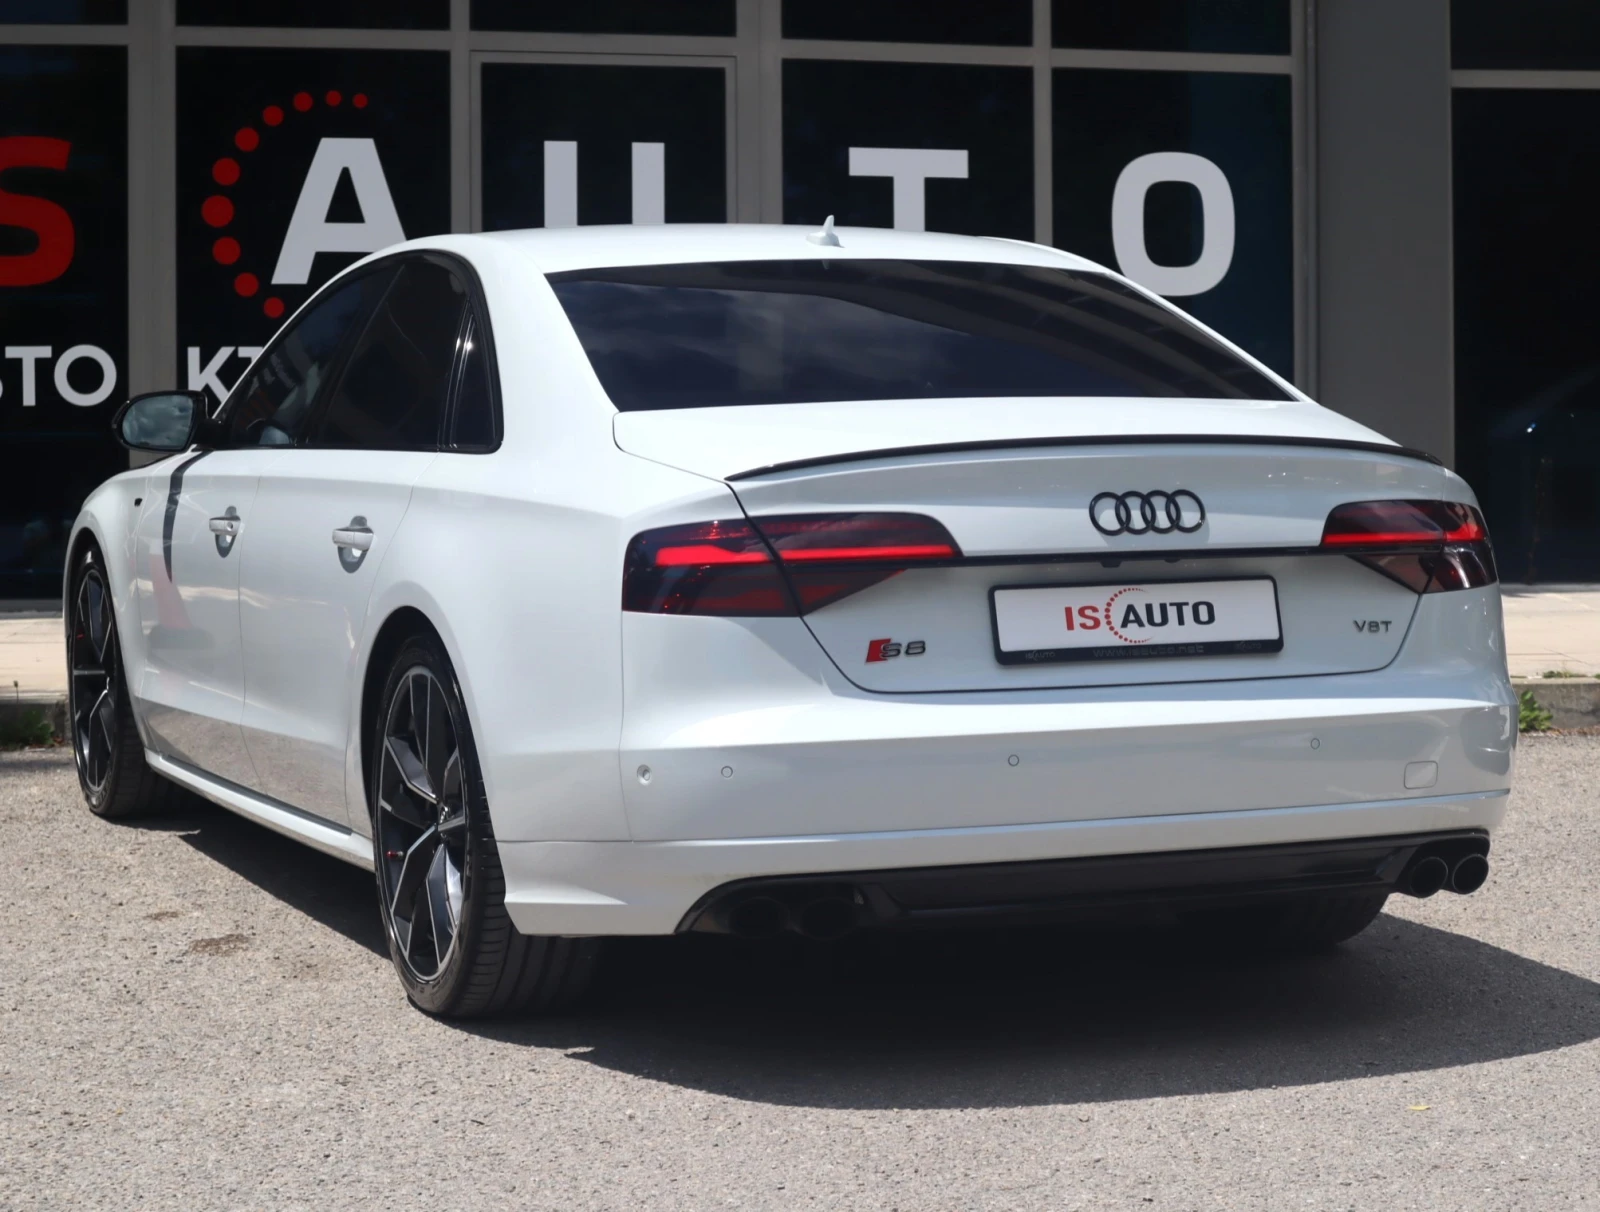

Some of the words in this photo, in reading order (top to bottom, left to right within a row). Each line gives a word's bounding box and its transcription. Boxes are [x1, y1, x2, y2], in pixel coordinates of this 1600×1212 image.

[1064, 605, 1101, 631] IS
[1120, 600, 1216, 629] AUTO
[1353, 619, 1393, 634] V8T
[879, 640, 926, 659] S8
